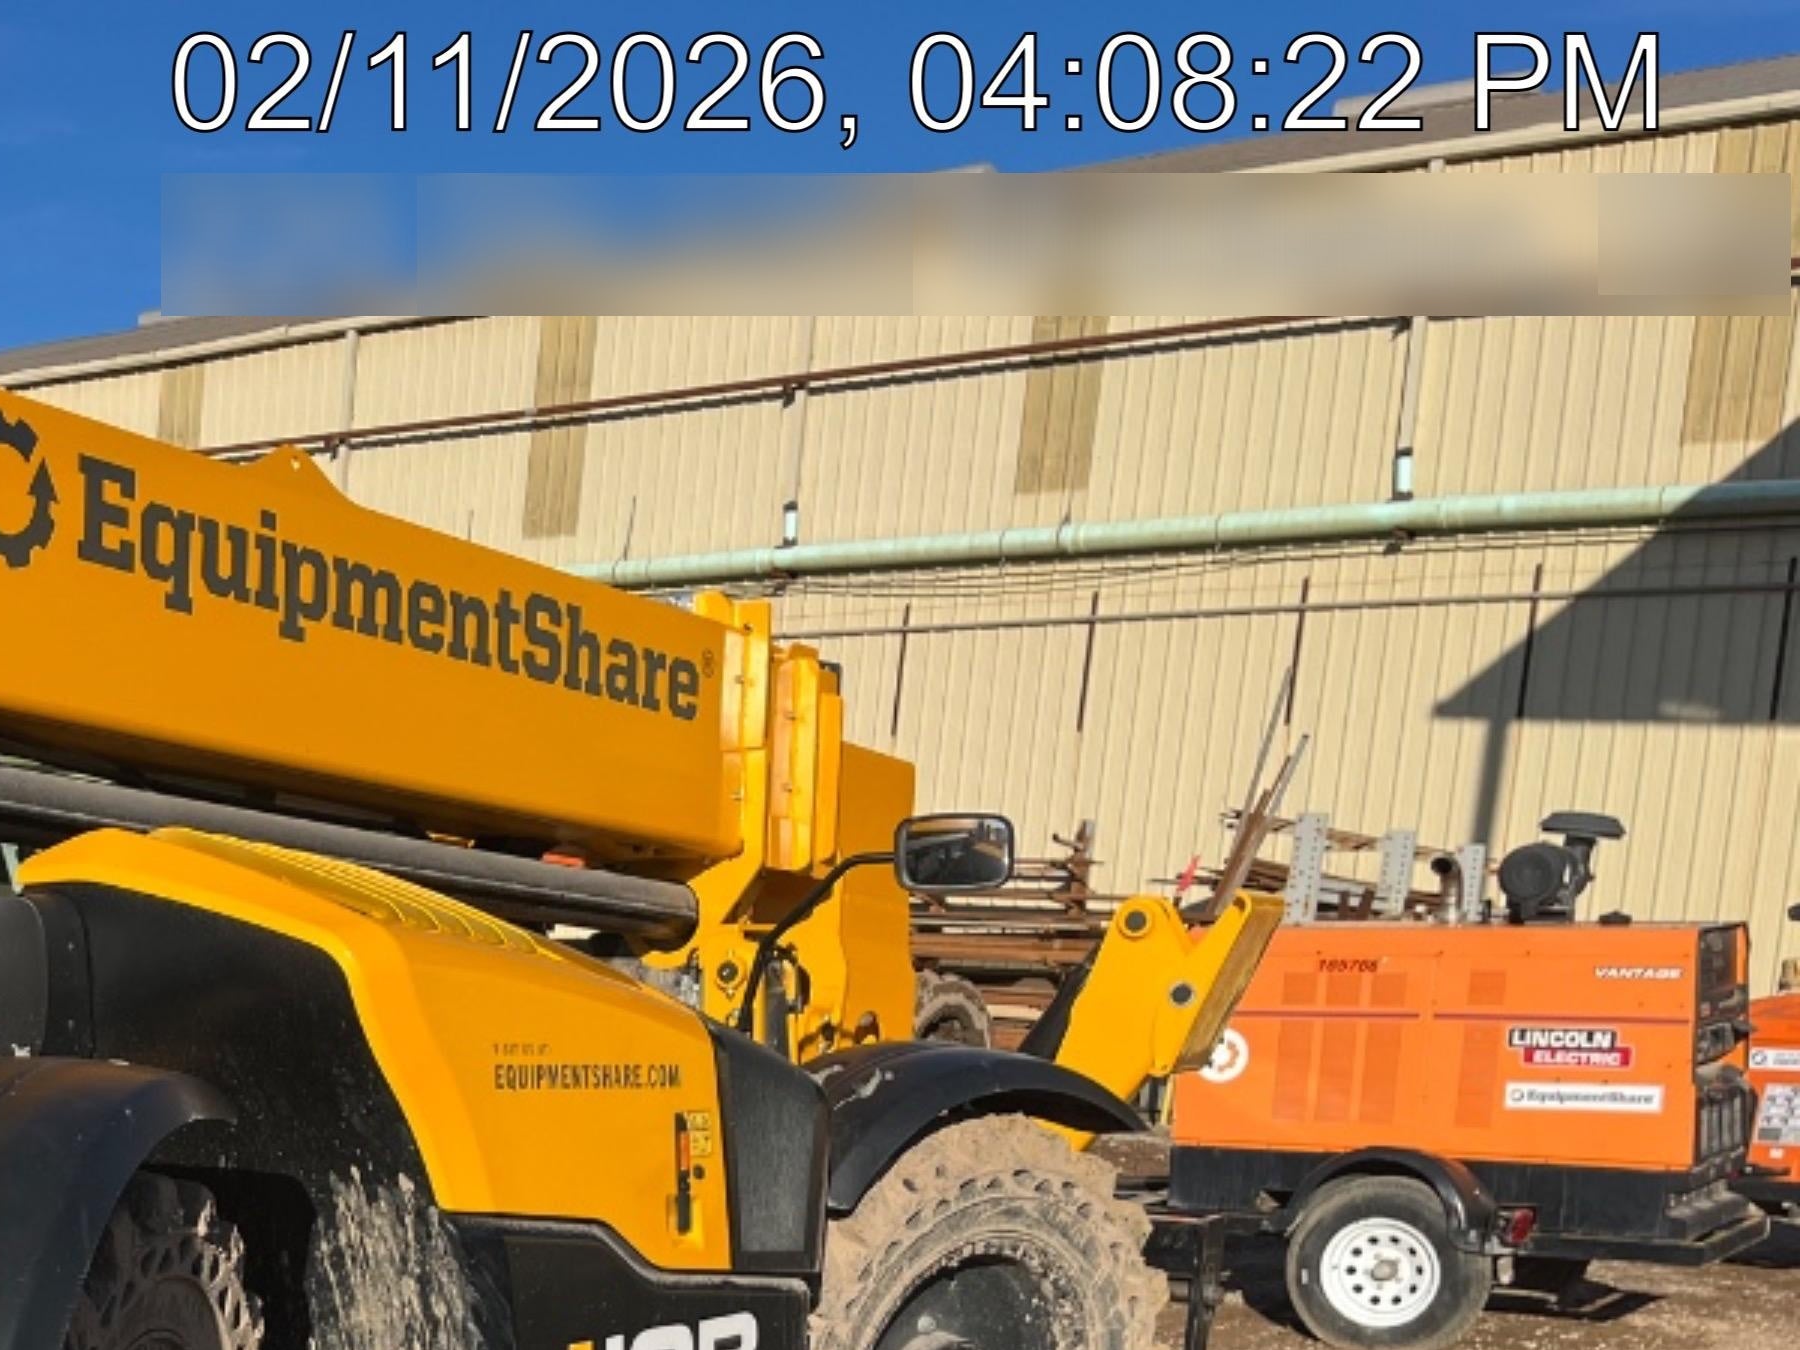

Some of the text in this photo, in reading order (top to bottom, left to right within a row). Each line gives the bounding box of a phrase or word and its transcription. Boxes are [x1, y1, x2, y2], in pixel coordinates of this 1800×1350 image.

[1594, 966, 1683, 980] VANTAGE
[1511, 1030, 1614, 1050] LINCOLN
[1531, 1050, 1623, 1067] ELECTRIC
[493, 1063, 681, 1092] EQUIPMENTSHARE.COM
[1526, 1088, 1655, 1105] EquipmentShare
